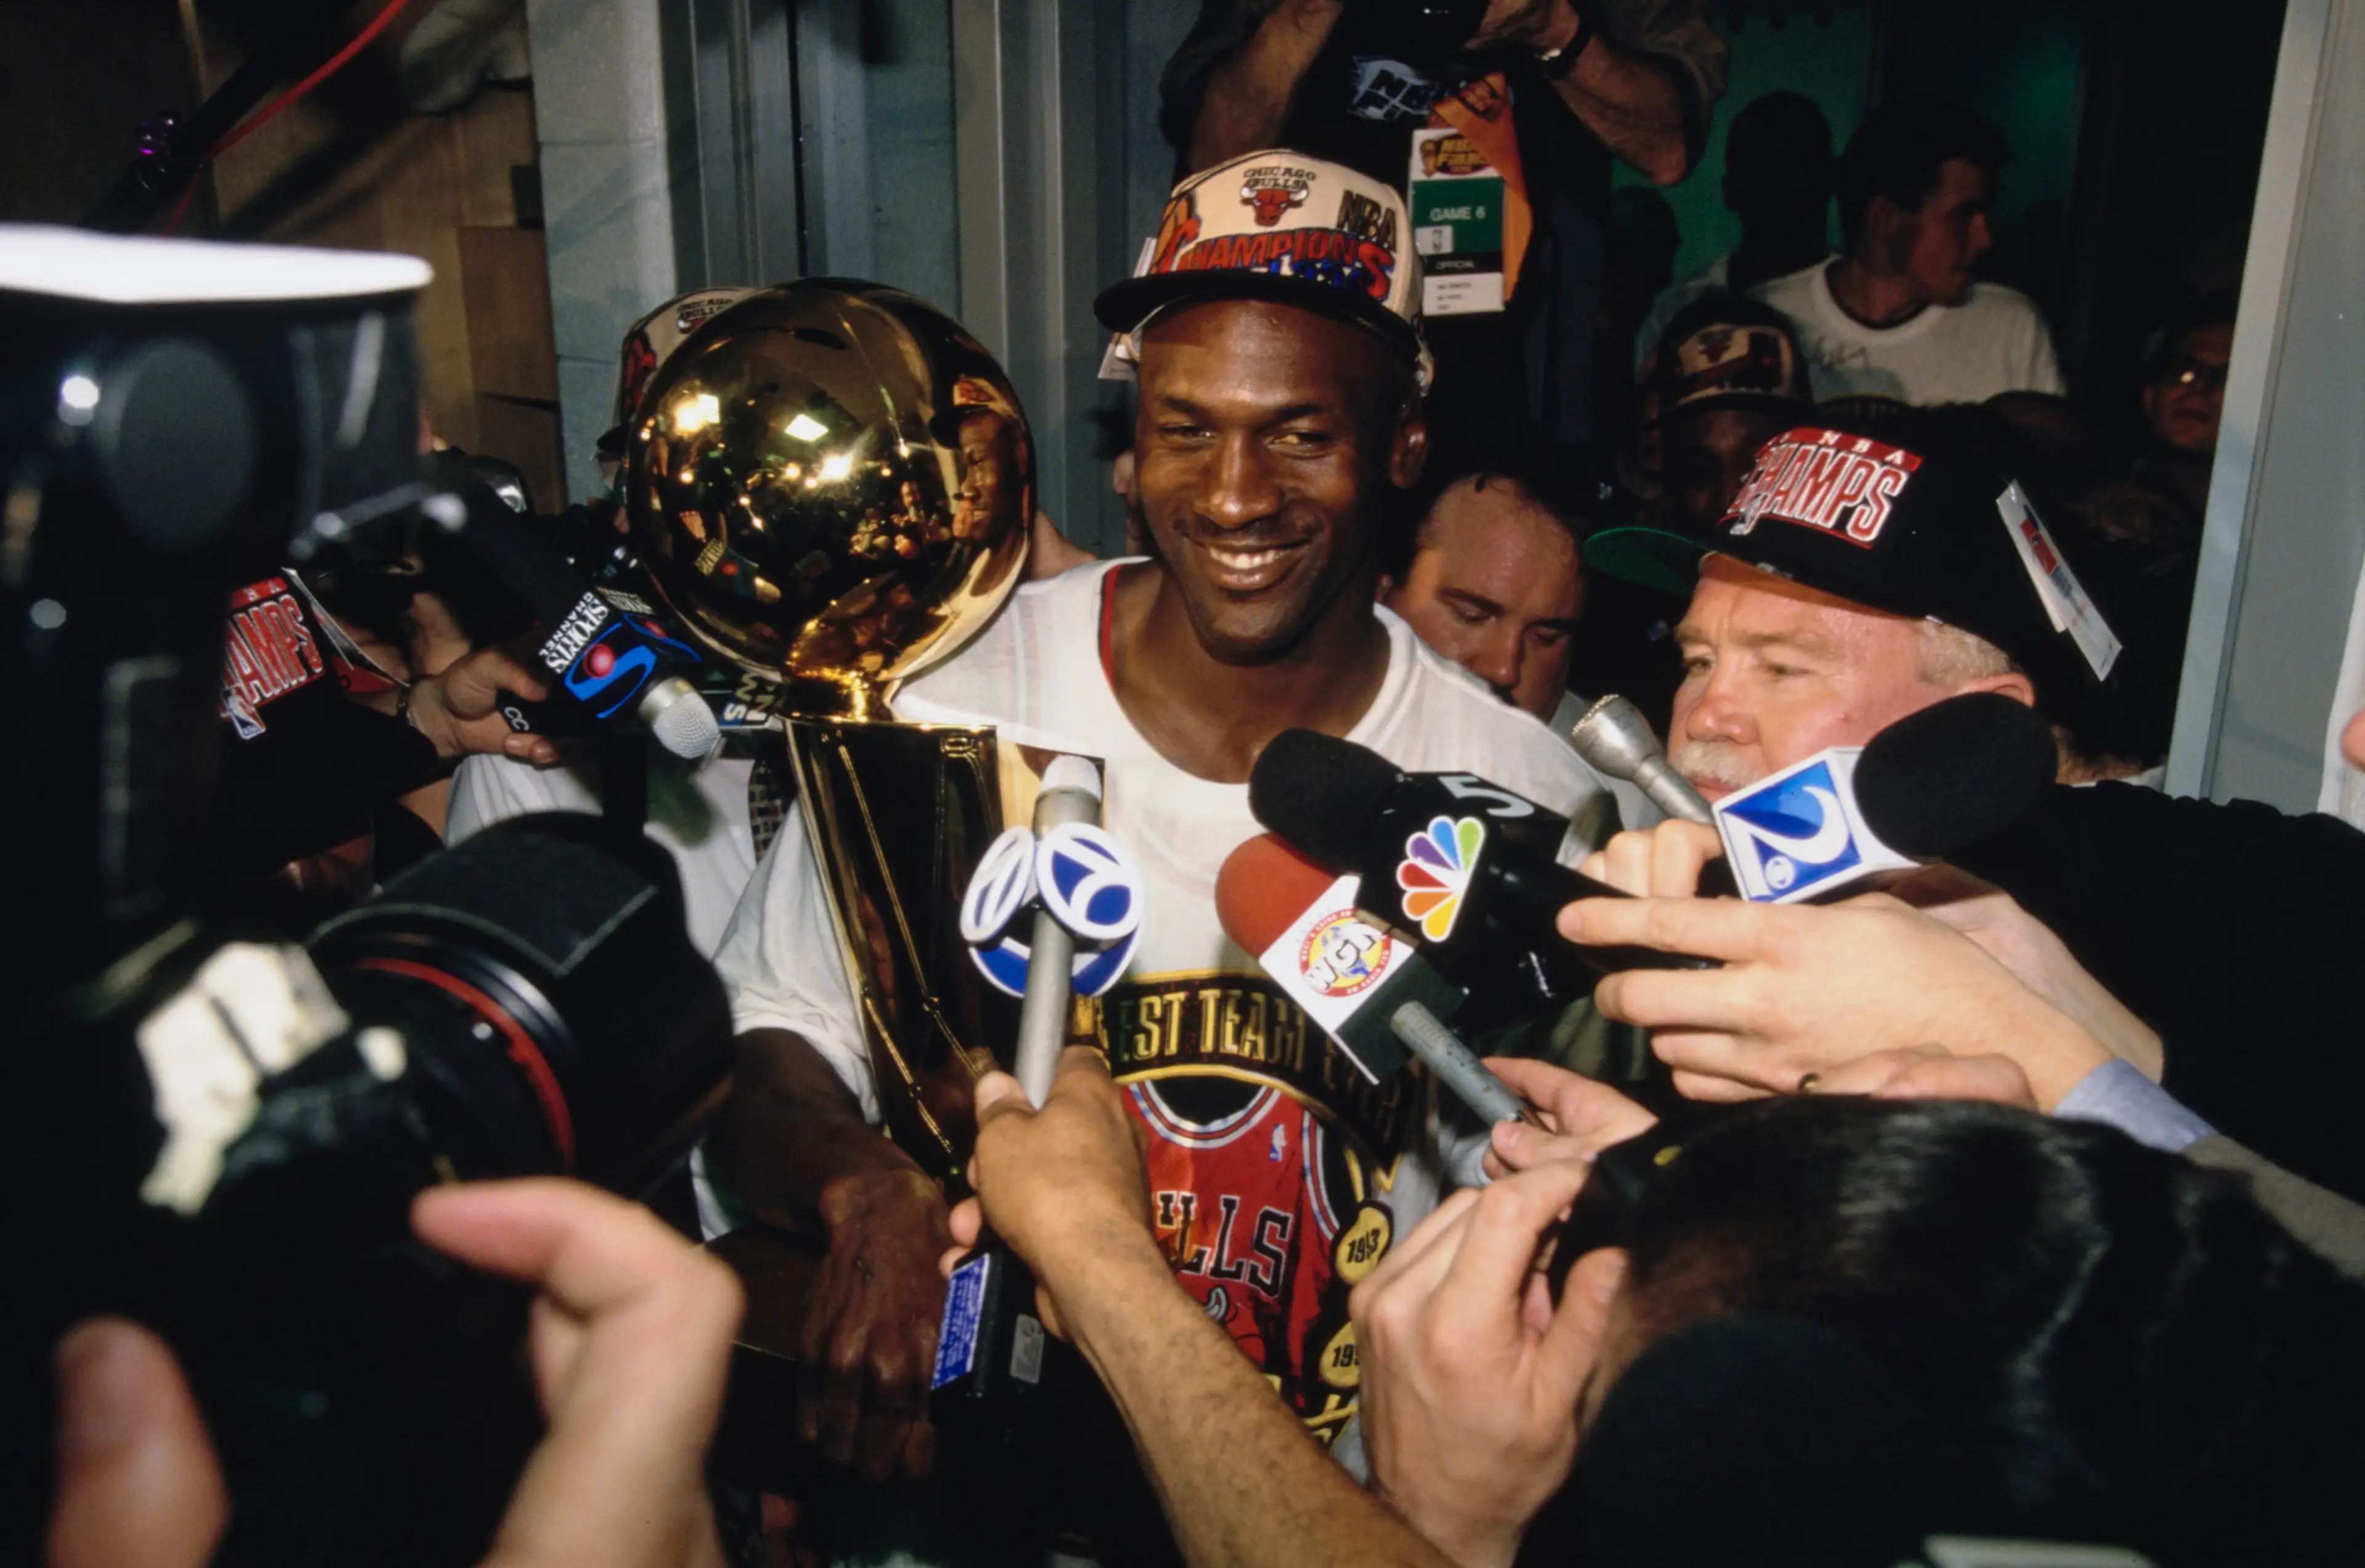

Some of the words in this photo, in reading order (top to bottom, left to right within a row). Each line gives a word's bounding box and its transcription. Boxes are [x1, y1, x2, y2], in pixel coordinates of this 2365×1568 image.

[1243, 167, 1317, 181] CHICAGO
[1249, 177, 1303, 188] BULLS
[1335, 189, 1397, 254] NBA
[1429, 206, 1471, 221] GAME
[1475, 206, 1486, 219] 6
[1160, 216, 1395, 300] CHAMPIONS
[1817, 430, 1906, 466] NBA
[1726, 443, 1910, 543] CHAMPS
[225, 593, 324, 705] AMPS
[538, 591, 594, 657] CHANNEL
[544, 599, 609, 674] SPORTS
[1438, 775, 1535, 818] 5
[1301, 919, 1385, 994] WGN
[1198, 988, 1306, 1072] TEAM
[1156, 1190, 1293, 1299] LLS
[1332, 1344, 1360, 1368] 19
